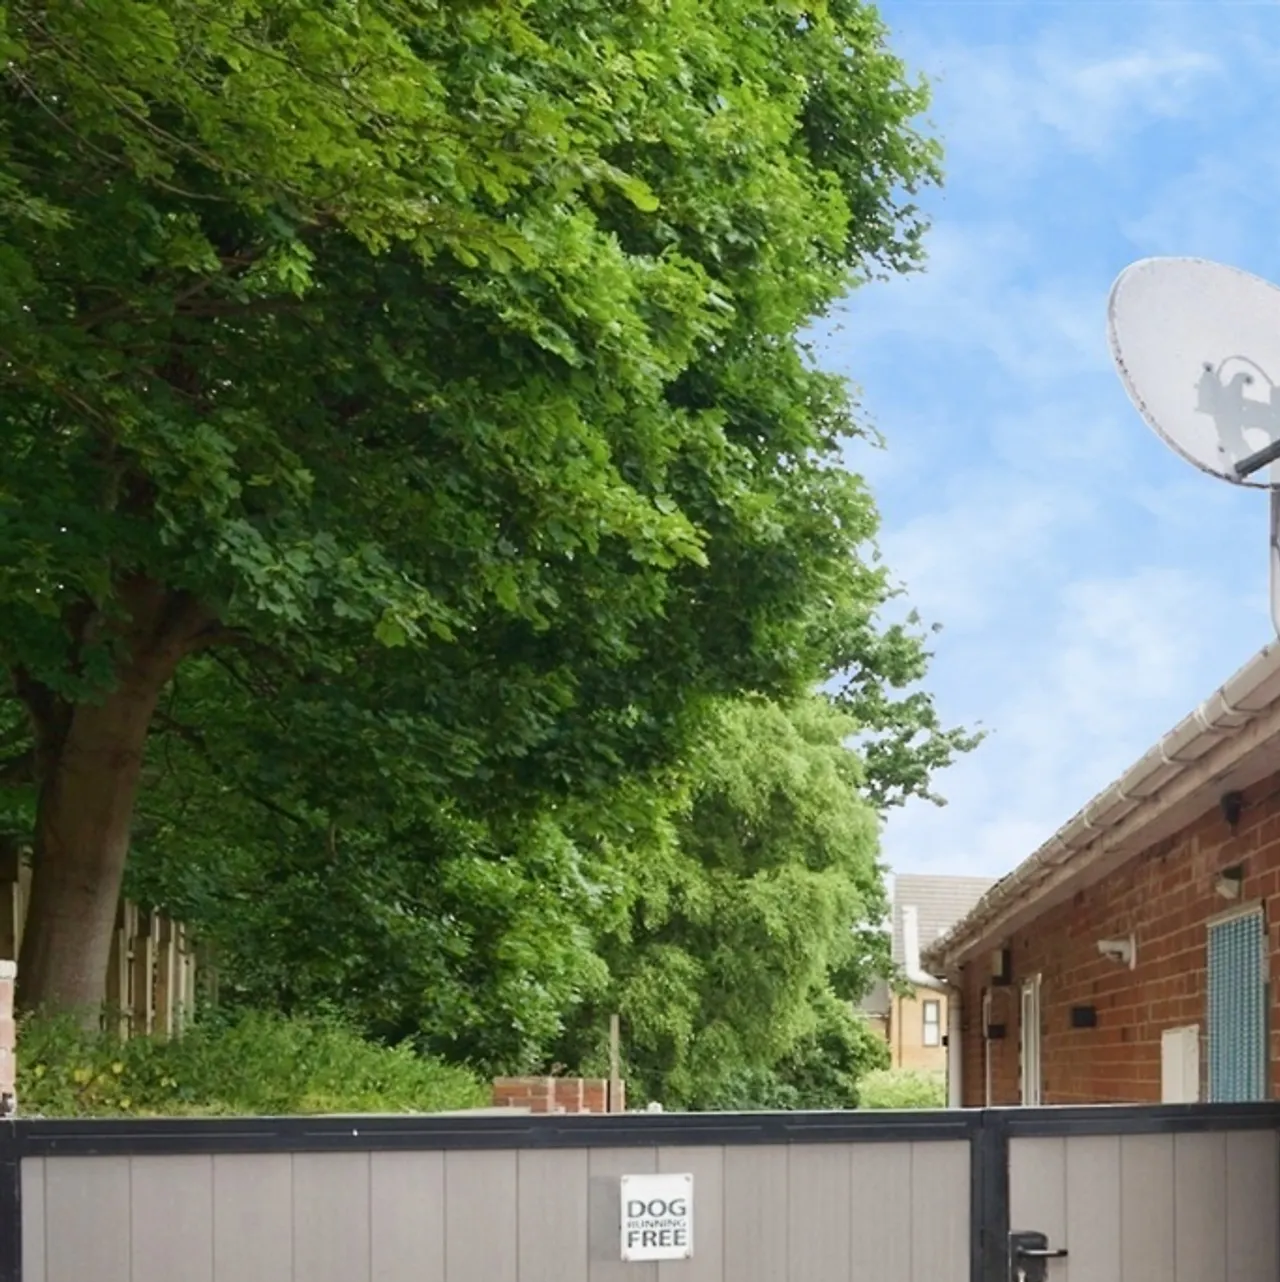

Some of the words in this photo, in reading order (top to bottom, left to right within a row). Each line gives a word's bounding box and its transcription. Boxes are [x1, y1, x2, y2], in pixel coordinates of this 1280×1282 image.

[627, 1199, 686, 1218] DOG
[627, 1219, 686, 1229] RUNNING
[627, 1229, 687, 1248] FREE
